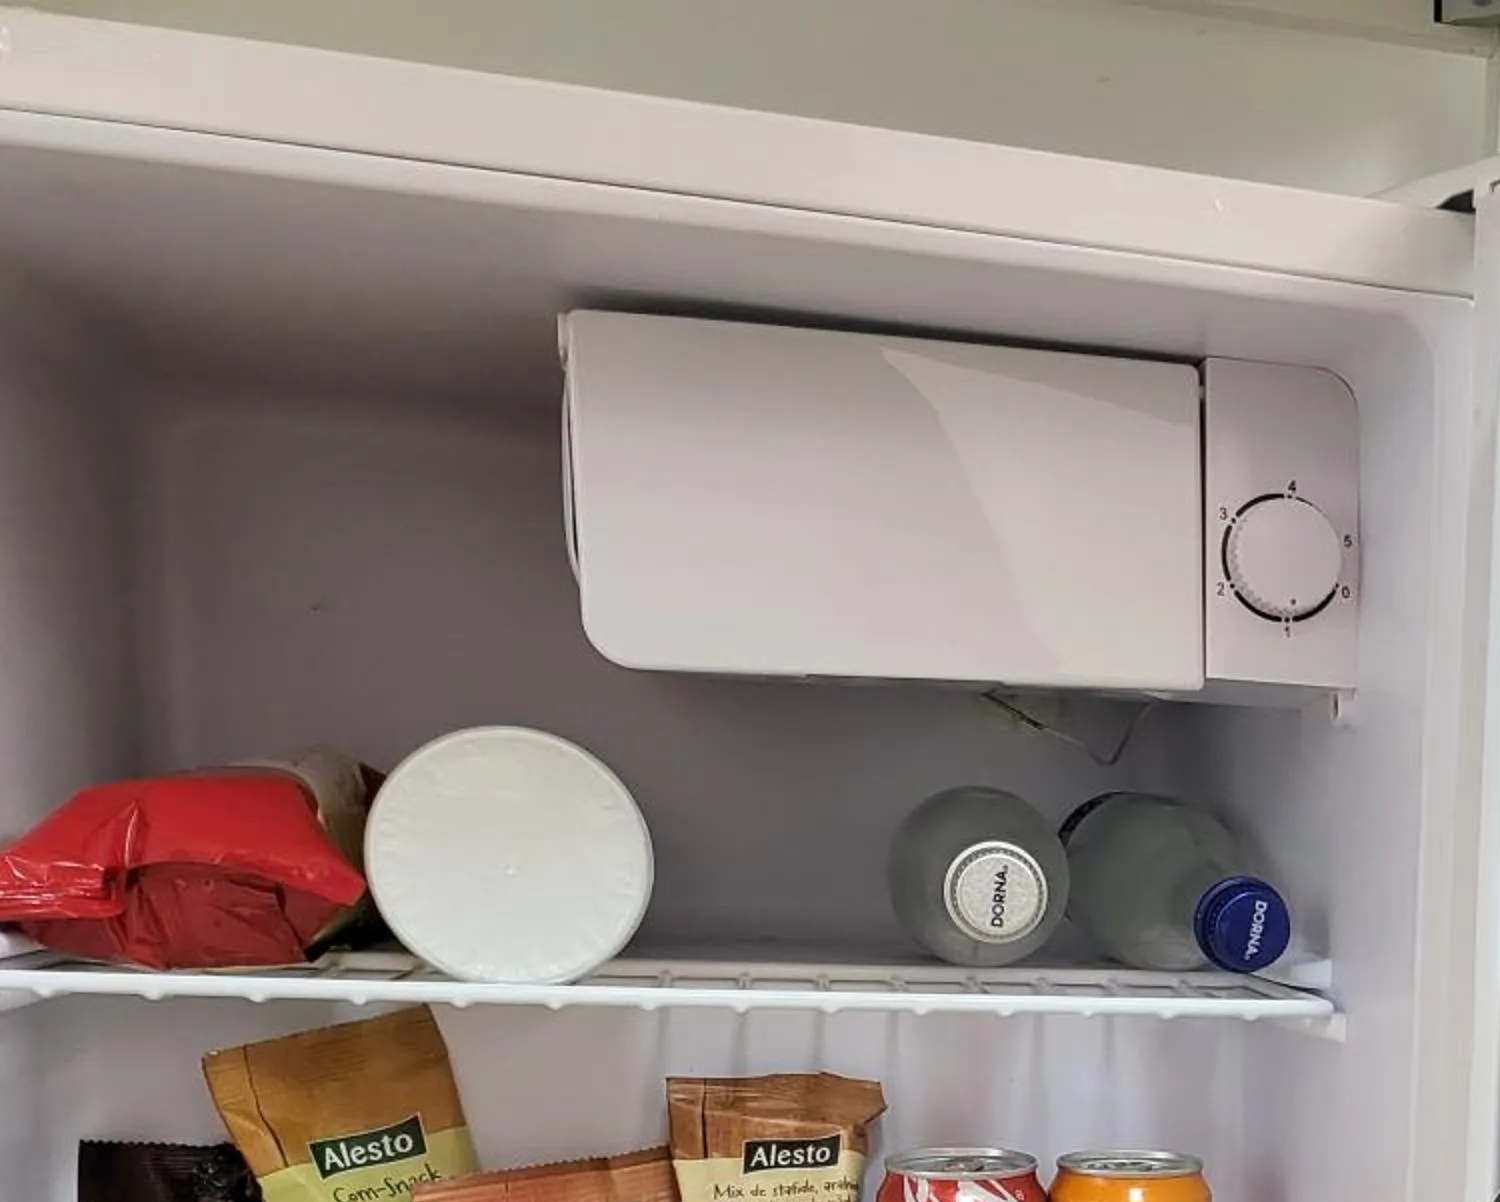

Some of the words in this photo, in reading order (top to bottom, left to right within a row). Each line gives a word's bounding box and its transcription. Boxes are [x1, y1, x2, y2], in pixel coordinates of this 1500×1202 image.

[1287, 480, 1297, 493] 4
[1219, 507, 1229, 521] 3
[1216, 582, 1225, 597] 2
[989, 867, 1009, 928] DORNA
[1245, 900, 1268, 959] DORNA
[324, 1133, 414, 1171] Alesto
[750, 1143, 831, 1167] Alesto
[713, 1183, 745, 1200] Mix
[750, 1183, 767, 1197] de
